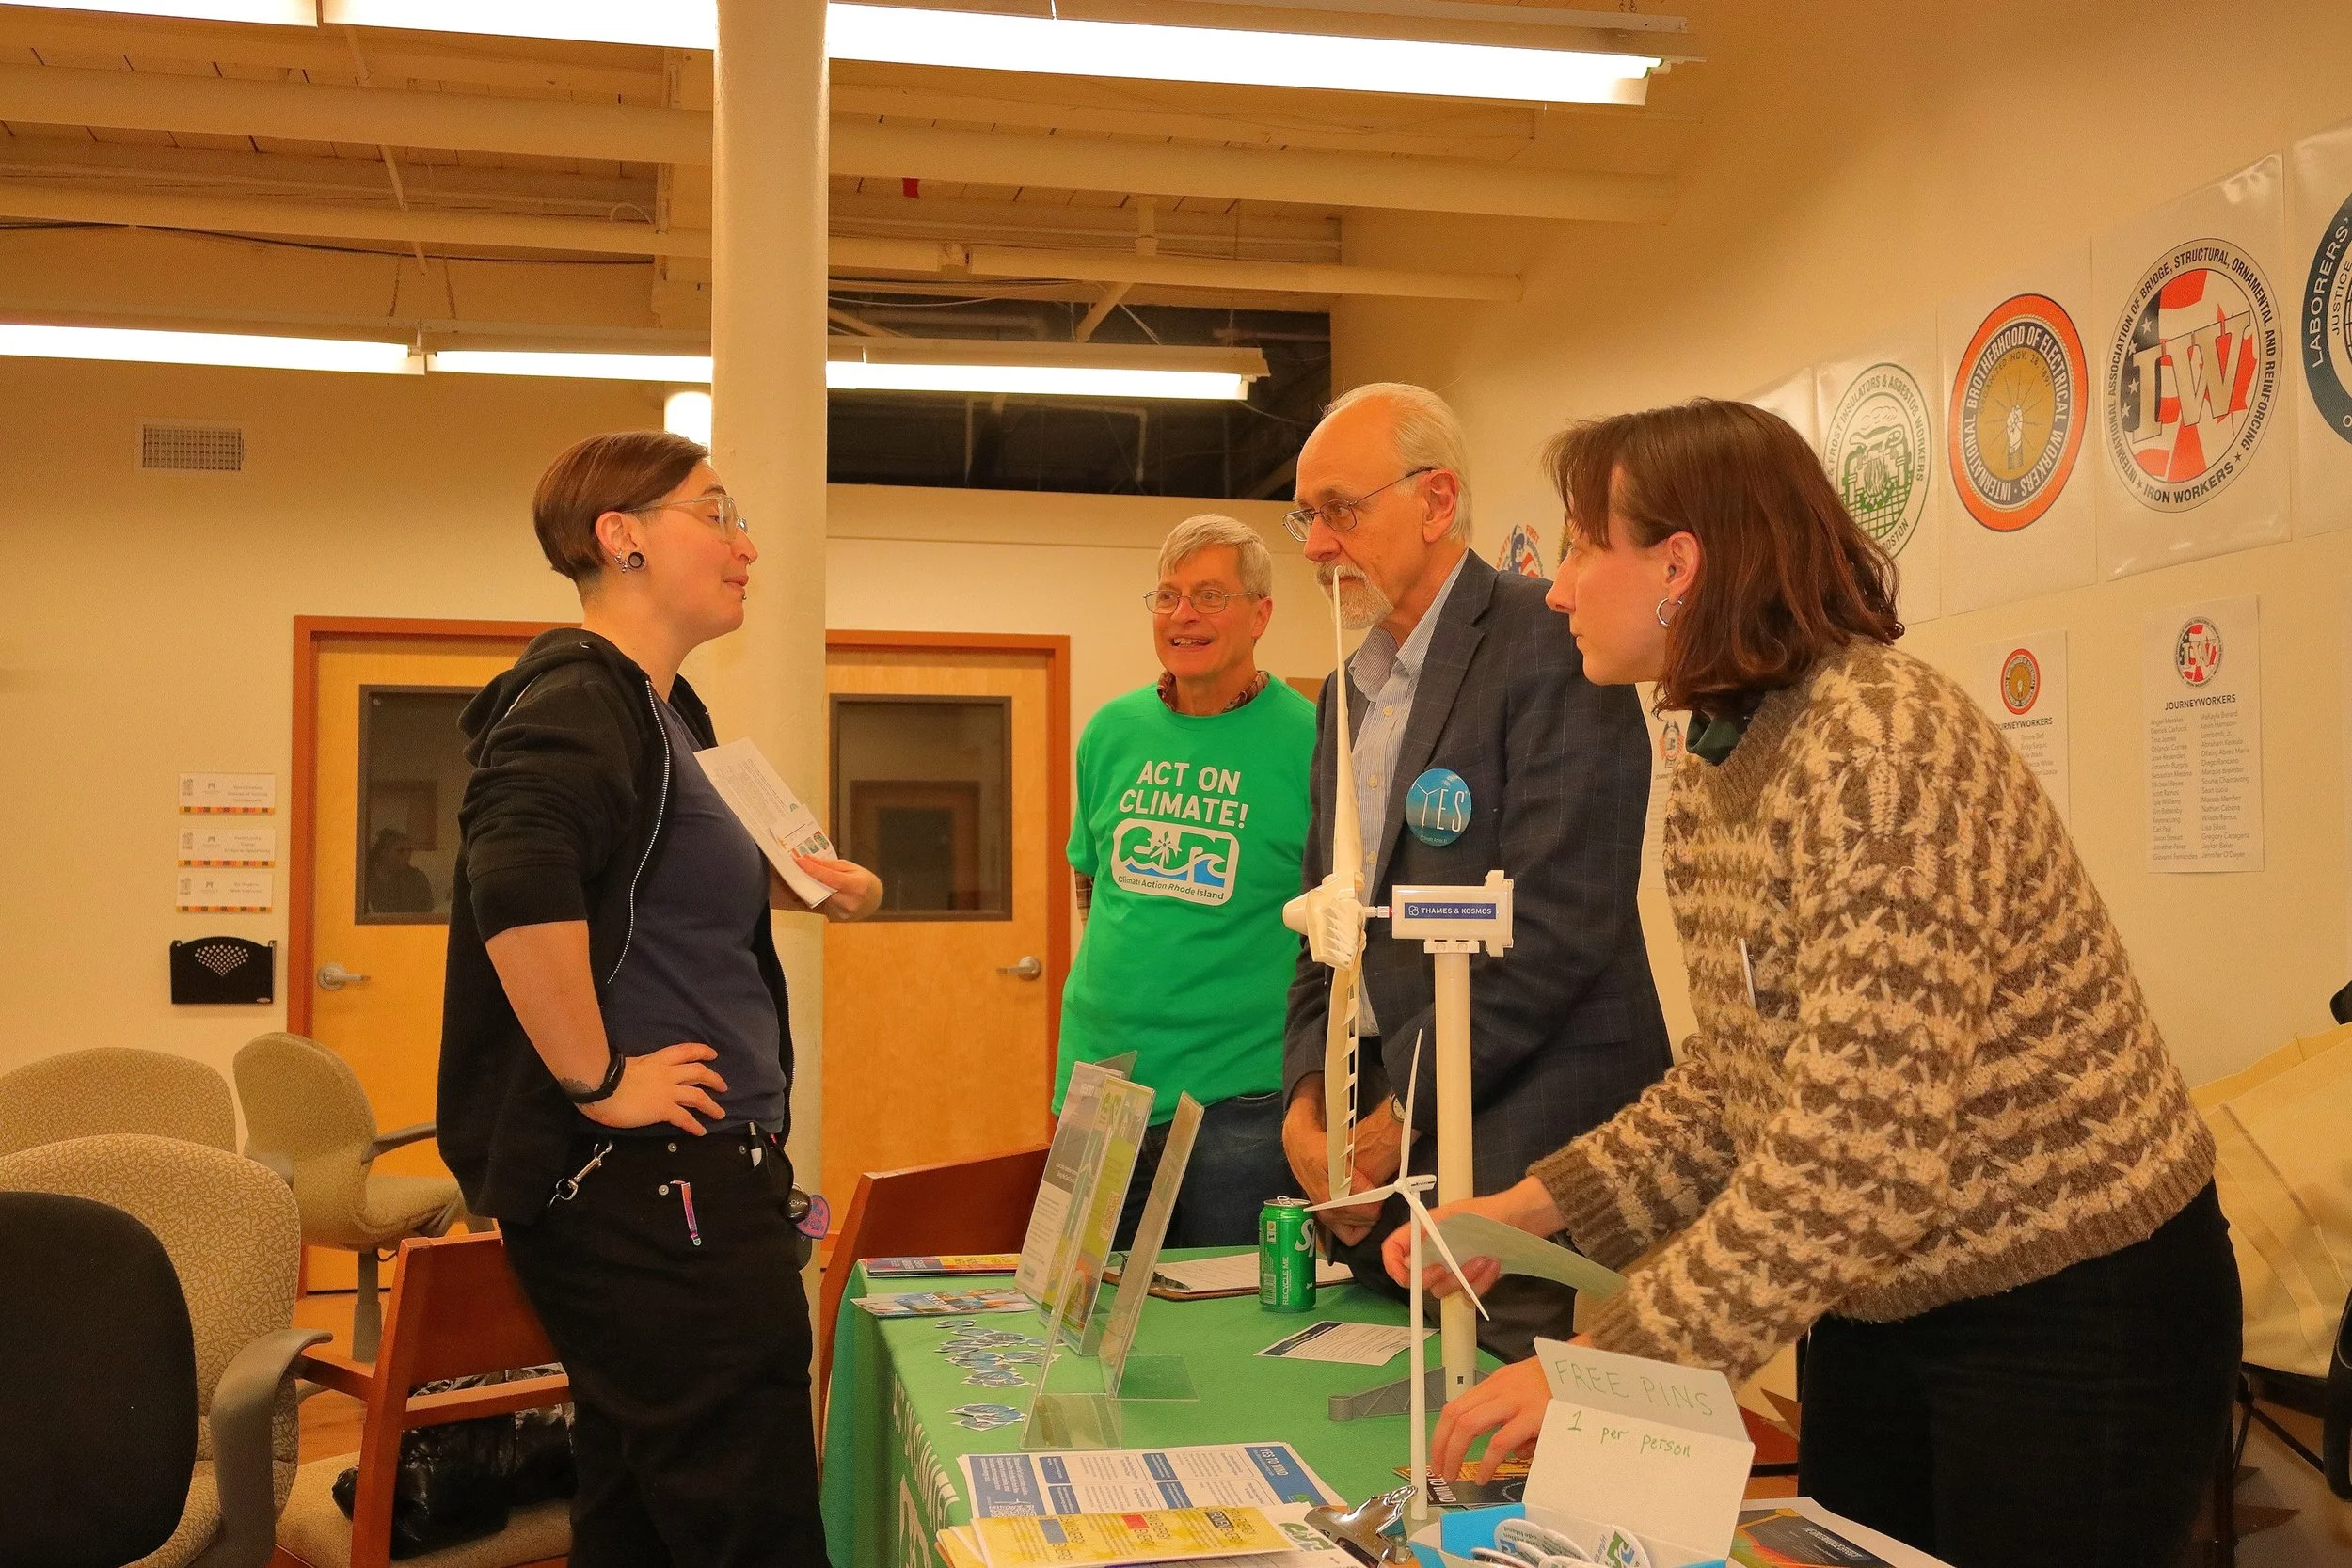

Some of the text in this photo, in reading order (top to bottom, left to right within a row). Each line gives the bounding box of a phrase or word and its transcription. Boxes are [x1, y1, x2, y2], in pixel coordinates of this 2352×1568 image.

[2309, 217, 2351, 368] LABORERS'
[2331, 261, 2352, 336] JUSTICE
[2107, 247, 2277, 483] INTERNATIONAL ASSOCIATION OF BRIDGE, STRUCTURAL, ORNAMENTAL AND REINFORCING
[1829, 424, 1844, 459] FROST
[1840, 374, 1880, 423] INSULATORS
[1882, 373, 1887, 388] &
[1888, 374, 1919, 418] ASBESTOS
[1915, 416, 1929, 482] WORKERS
[1963, 325, 2069, 502] INTERNATIONAL BROTHERHOOD OF ELECTRICAL WORKERS
[2143, 461, 2234, 504] IRON WORKERS
[2165, 694, 2236, 710] JOURNEYWORKERS
[1136, 760, 1241, 795] ACT ON
[1119, 788, 1248, 829] CLIMATE!
[1411, 780, 1466, 832] YES
[1141, 879, 1167, 890] Action
[1168, 883, 1196, 895] Rhode
[1196, 888, 1224, 900] Island
[1281, 1256, 1290, 1306] RECYCLE ME
[1555, 1360, 1713, 1417] FREE PINS
[1567, 1409, 1691, 1458] 1 per person
